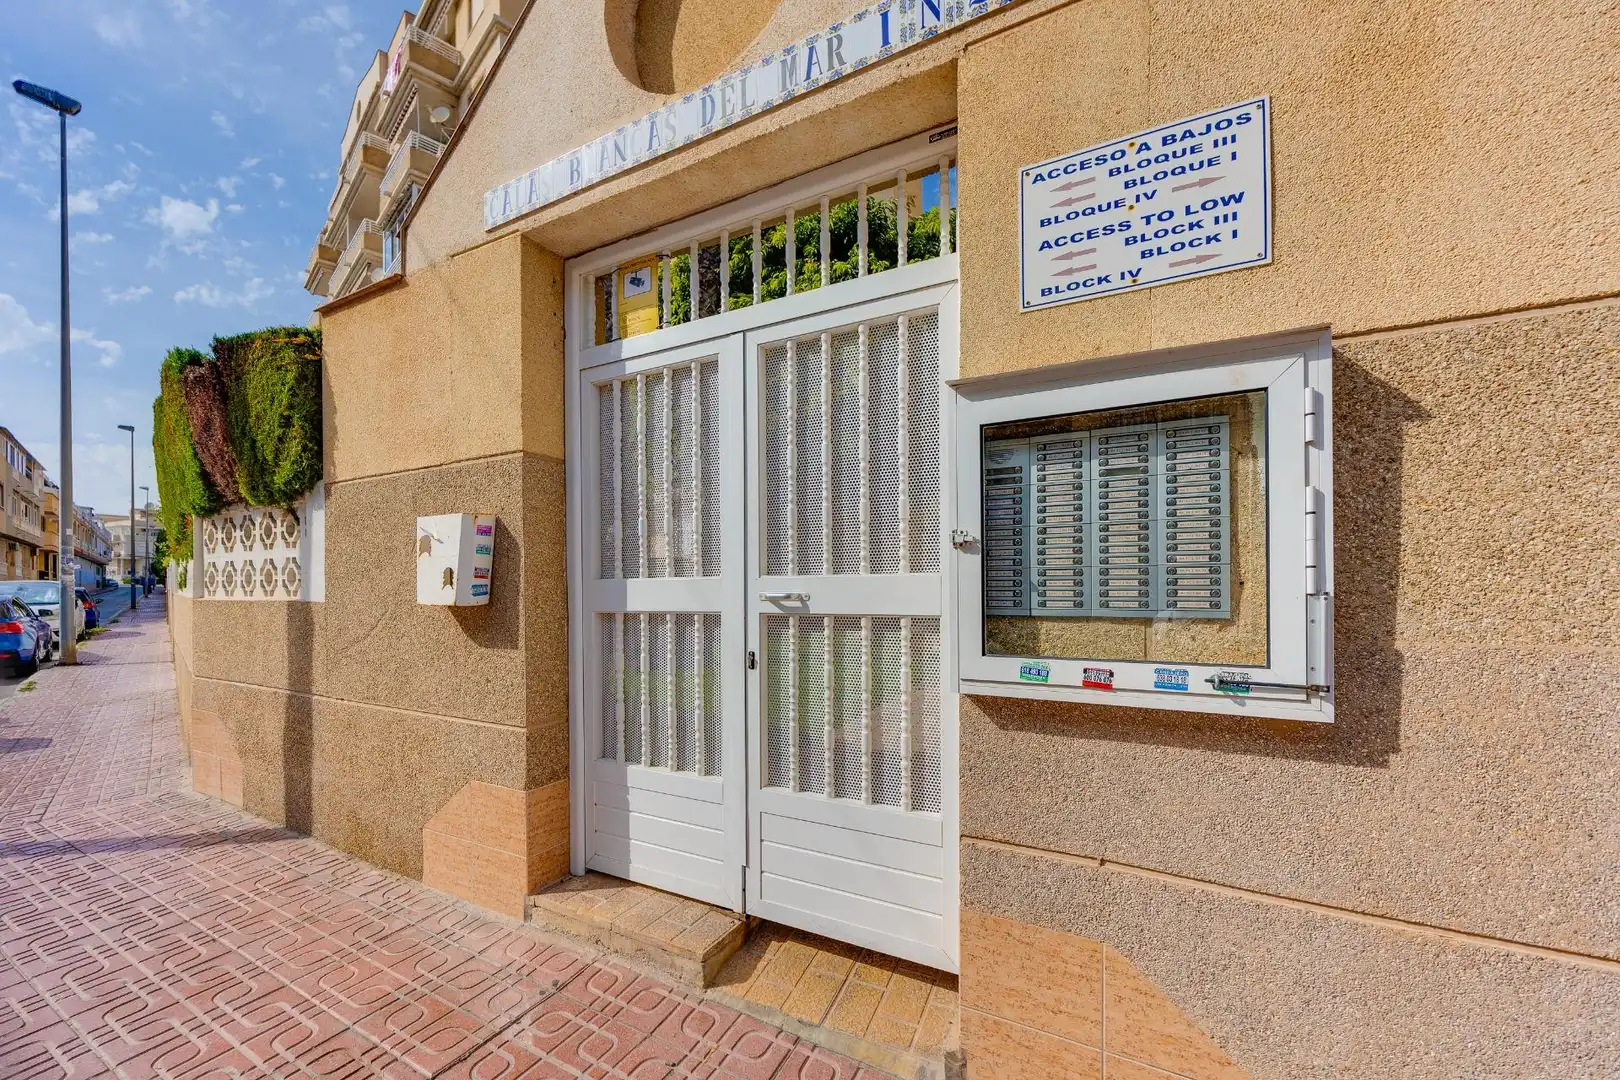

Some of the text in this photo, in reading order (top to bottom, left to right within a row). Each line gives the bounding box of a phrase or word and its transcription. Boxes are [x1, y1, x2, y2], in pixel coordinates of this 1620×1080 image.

[569, 112, 677, 187] BANCAS
[701, 77, 756, 127] DEL
[779, 33, 847, 93] MAR
[1031, 112, 1253, 185] ACCESO A BAJOS
[1108, 133, 1237, 178] BLOQUE III
[1123, 151, 1237, 190] BLOQUE I
[1038, 191, 1246, 251] ACCESS TO LOW
[1039, 189, 1158, 228] BLOQUE IV
[1124, 211, 1238, 247] BLOCK III
[1140, 229, 1238, 260] BLOCK I
[1040, 267, 1143, 297] BLOCK IV
